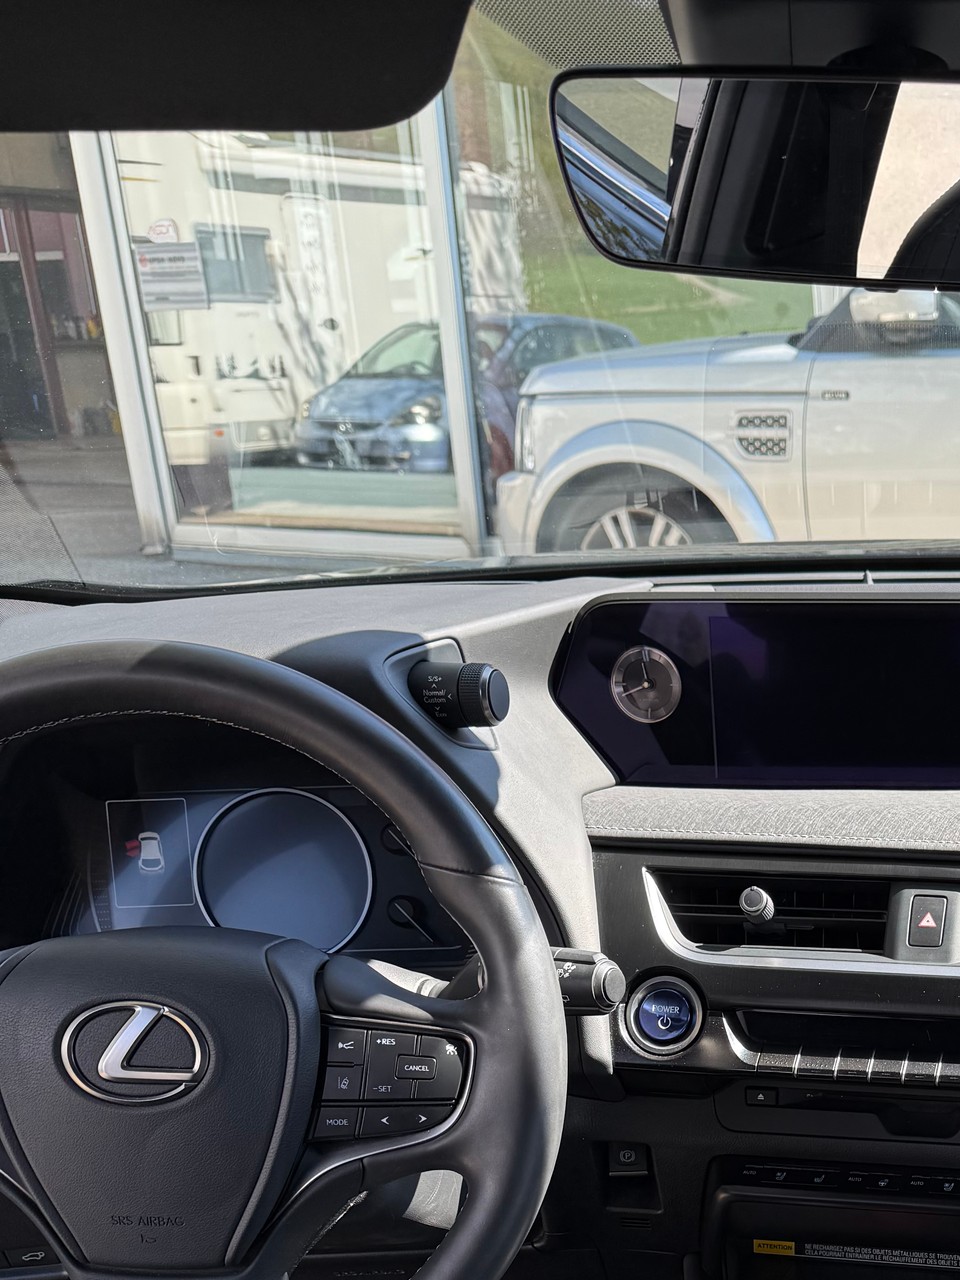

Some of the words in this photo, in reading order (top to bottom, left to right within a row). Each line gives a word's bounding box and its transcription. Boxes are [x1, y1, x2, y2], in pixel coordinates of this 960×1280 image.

[652, 1004, 680, 1014] POWER
[404, 1064, 430, 1072] CANCEL
[326, 1118, 349, 1126] MODE
[111, 1215, 133, 1226] SRS
[138, 1216, 186, 1227] AIRBAG
[757, 1243, 793, 1251] ATTENTION
